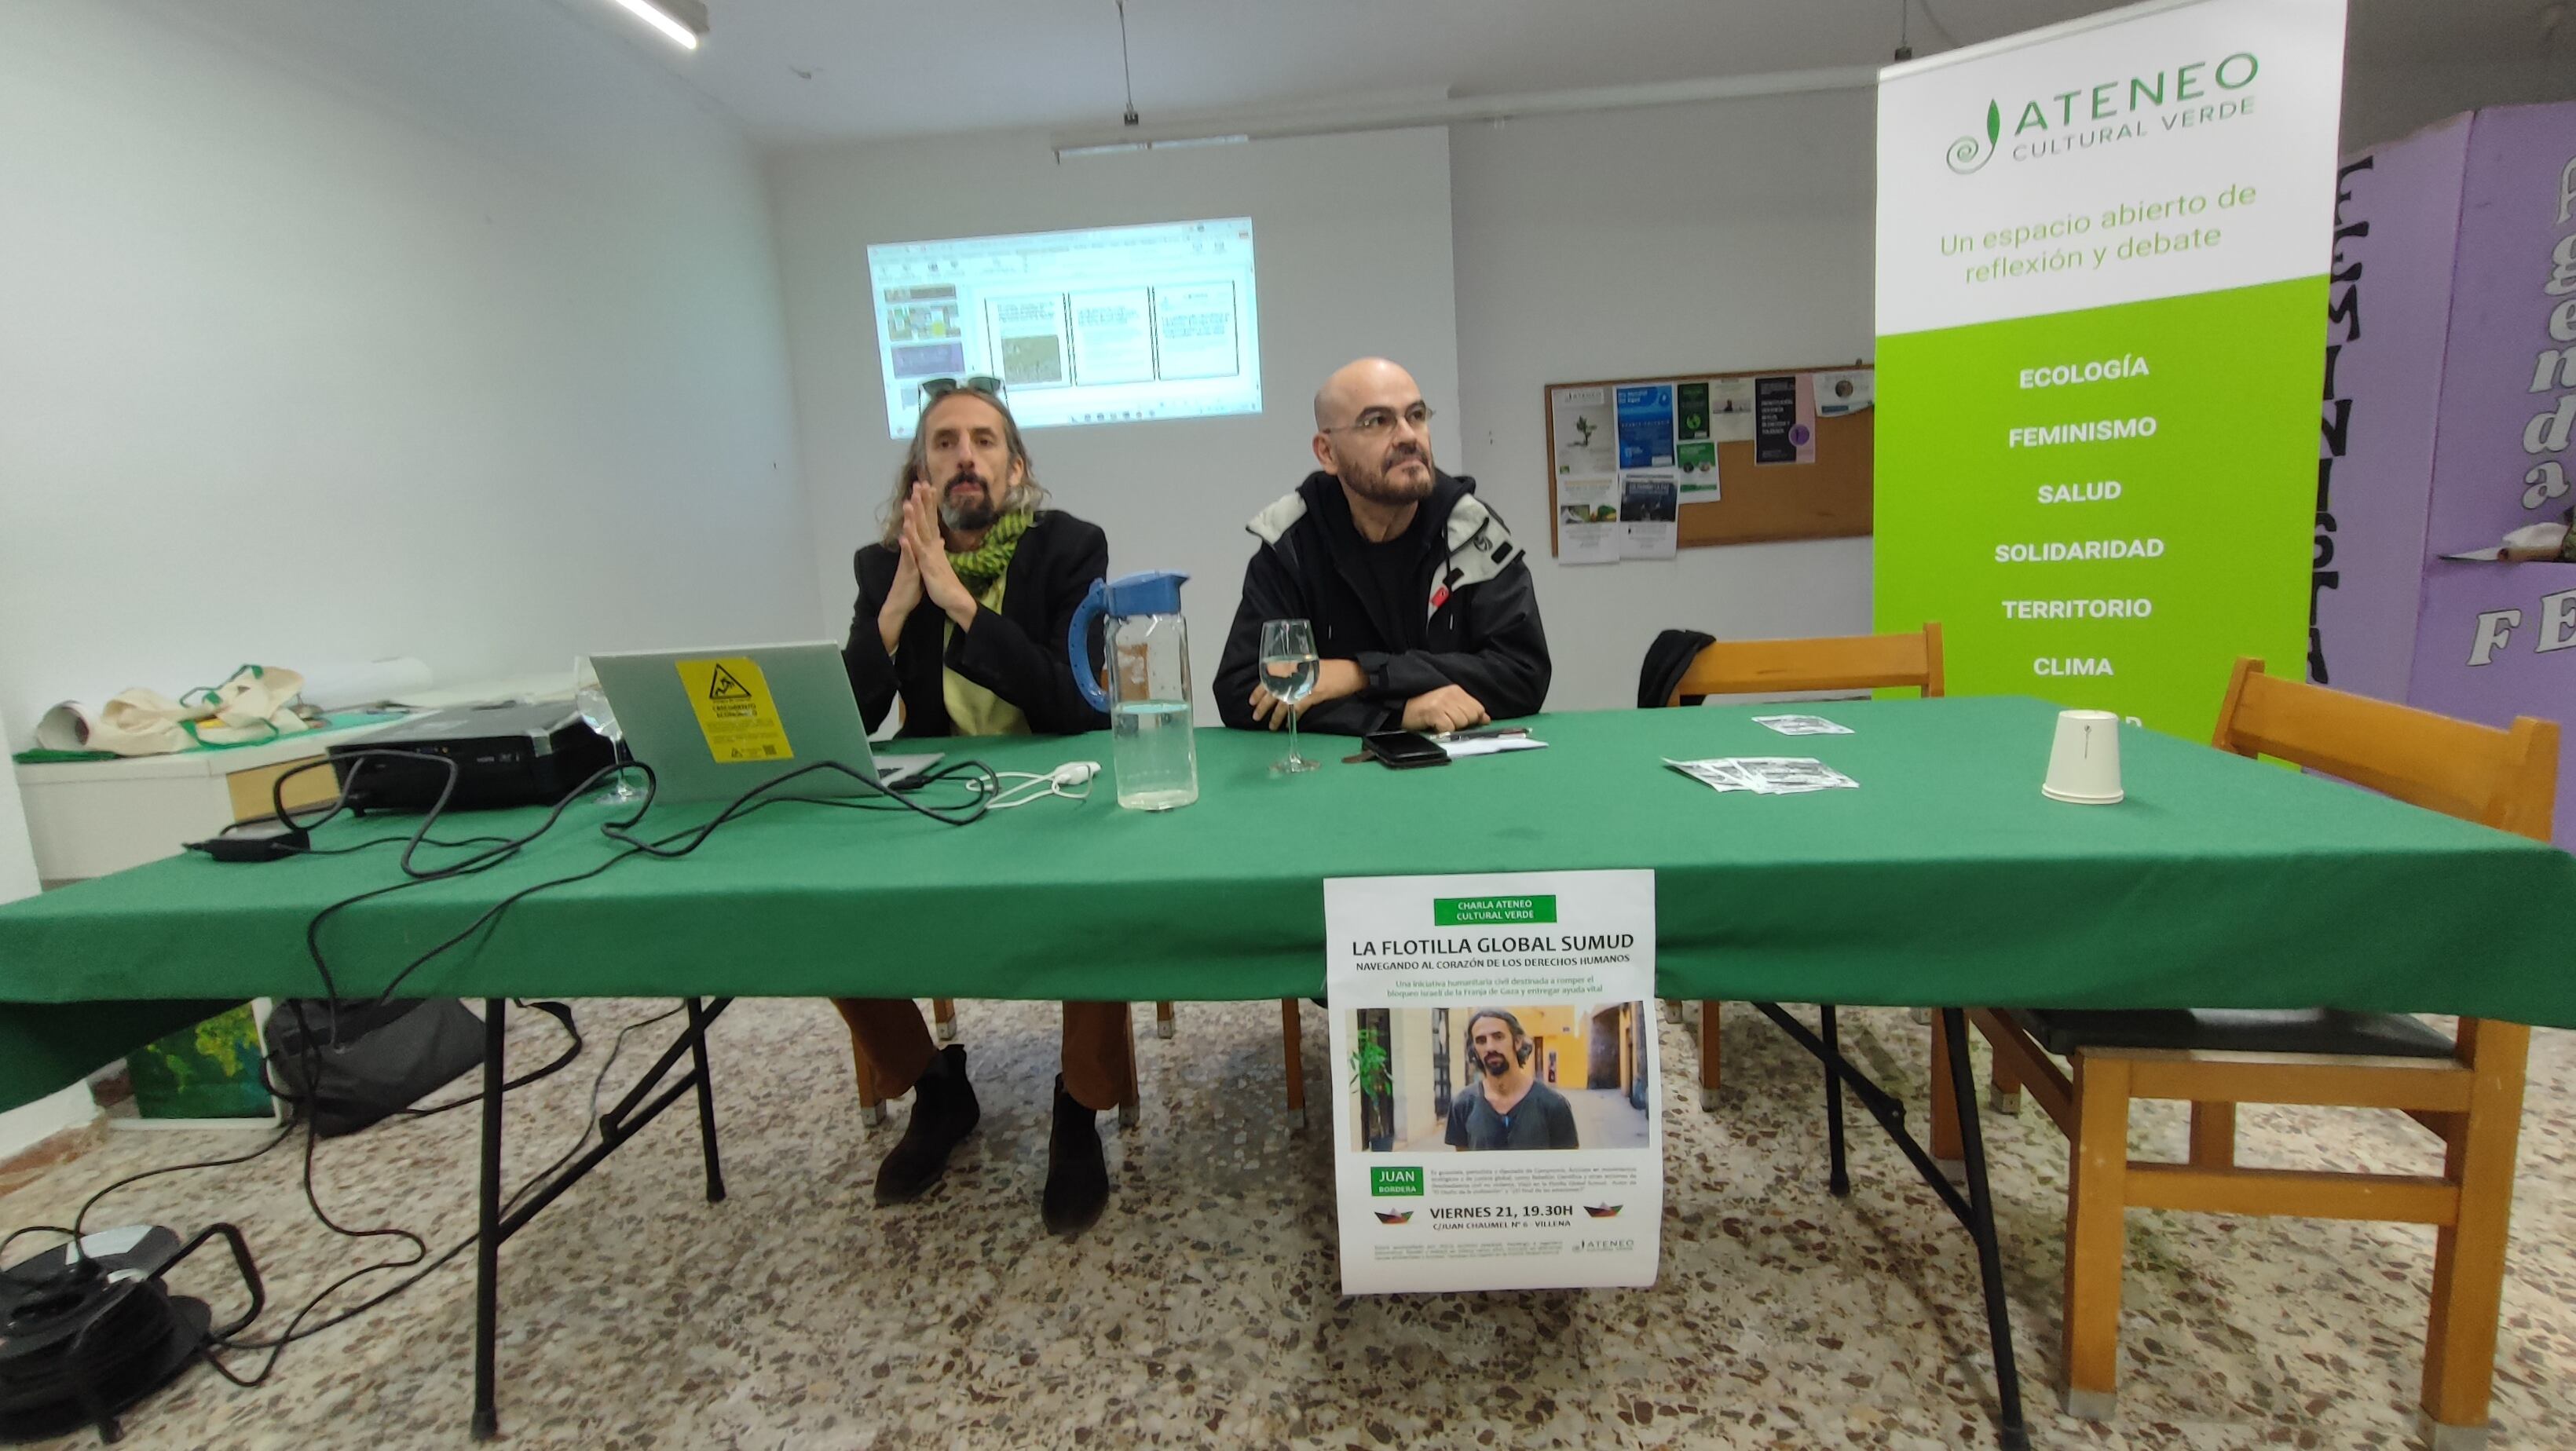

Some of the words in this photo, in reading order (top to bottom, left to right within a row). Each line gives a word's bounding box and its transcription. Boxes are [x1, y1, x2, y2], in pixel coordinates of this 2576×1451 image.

[2014, 53, 2259, 135] ATENEO
[2011, 122, 2147, 163] CULTURAL
[2162, 97, 2255, 131] VERDE
[1941, 232, 1975, 256] Un
[1982, 214, 2091, 251] espacio
[2101, 191, 2207, 231] abierto
[2218, 182, 2257, 209] de
[1966, 246, 2084, 283] reflexión
[2092, 246, 2106, 271] y
[2117, 225, 2221, 262] debate
[2019, 354, 2149, 389] ECOLOGÍA
[2009, 417, 2157, 448] FEMINISMO
[2037, 481, 2121, 503] SALUD
[1995, 539, 2164, 562] SOLIDARIDAD
[2002, 599, 2152, 619] TERRITORIO
[2033, 658, 2113, 676] CLIMA
[1457, 912, 1502, 921] CULTURAL
[1505, 910, 1534, 919] VERDE
[1458, 900, 1494, 910] CHARLA
[1496, 900, 1532, 908] ATENEO
[1352, 941, 1376, 956] LA
[1383, 938, 1472, 955] FLOTILLA
[1477, 936, 1557, 952] GLOBAL
[1562, 934, 1634, 950] SUMUD
[1356, 961, 1419, 970] NAVEGANDO
[1436, 957, 1484, 969] CORAZÓN
[1487, 959, 1500, 967] DE
[1502, 958, 1521, 967] LOS
[1524, 957, 1577, 967] DERECHOS
[1580, 955, 1630, 964] HUMANOS
[1562, 985, 1585, 994] ayuda
[1379, 1170, 1414, 1182] JUAN
[1430, 1206, 1491, 1219] VIERNES
[1495, 1206, 1519, 1219] 21,
[1522, 1205, 1573, 1217] 19.30H
